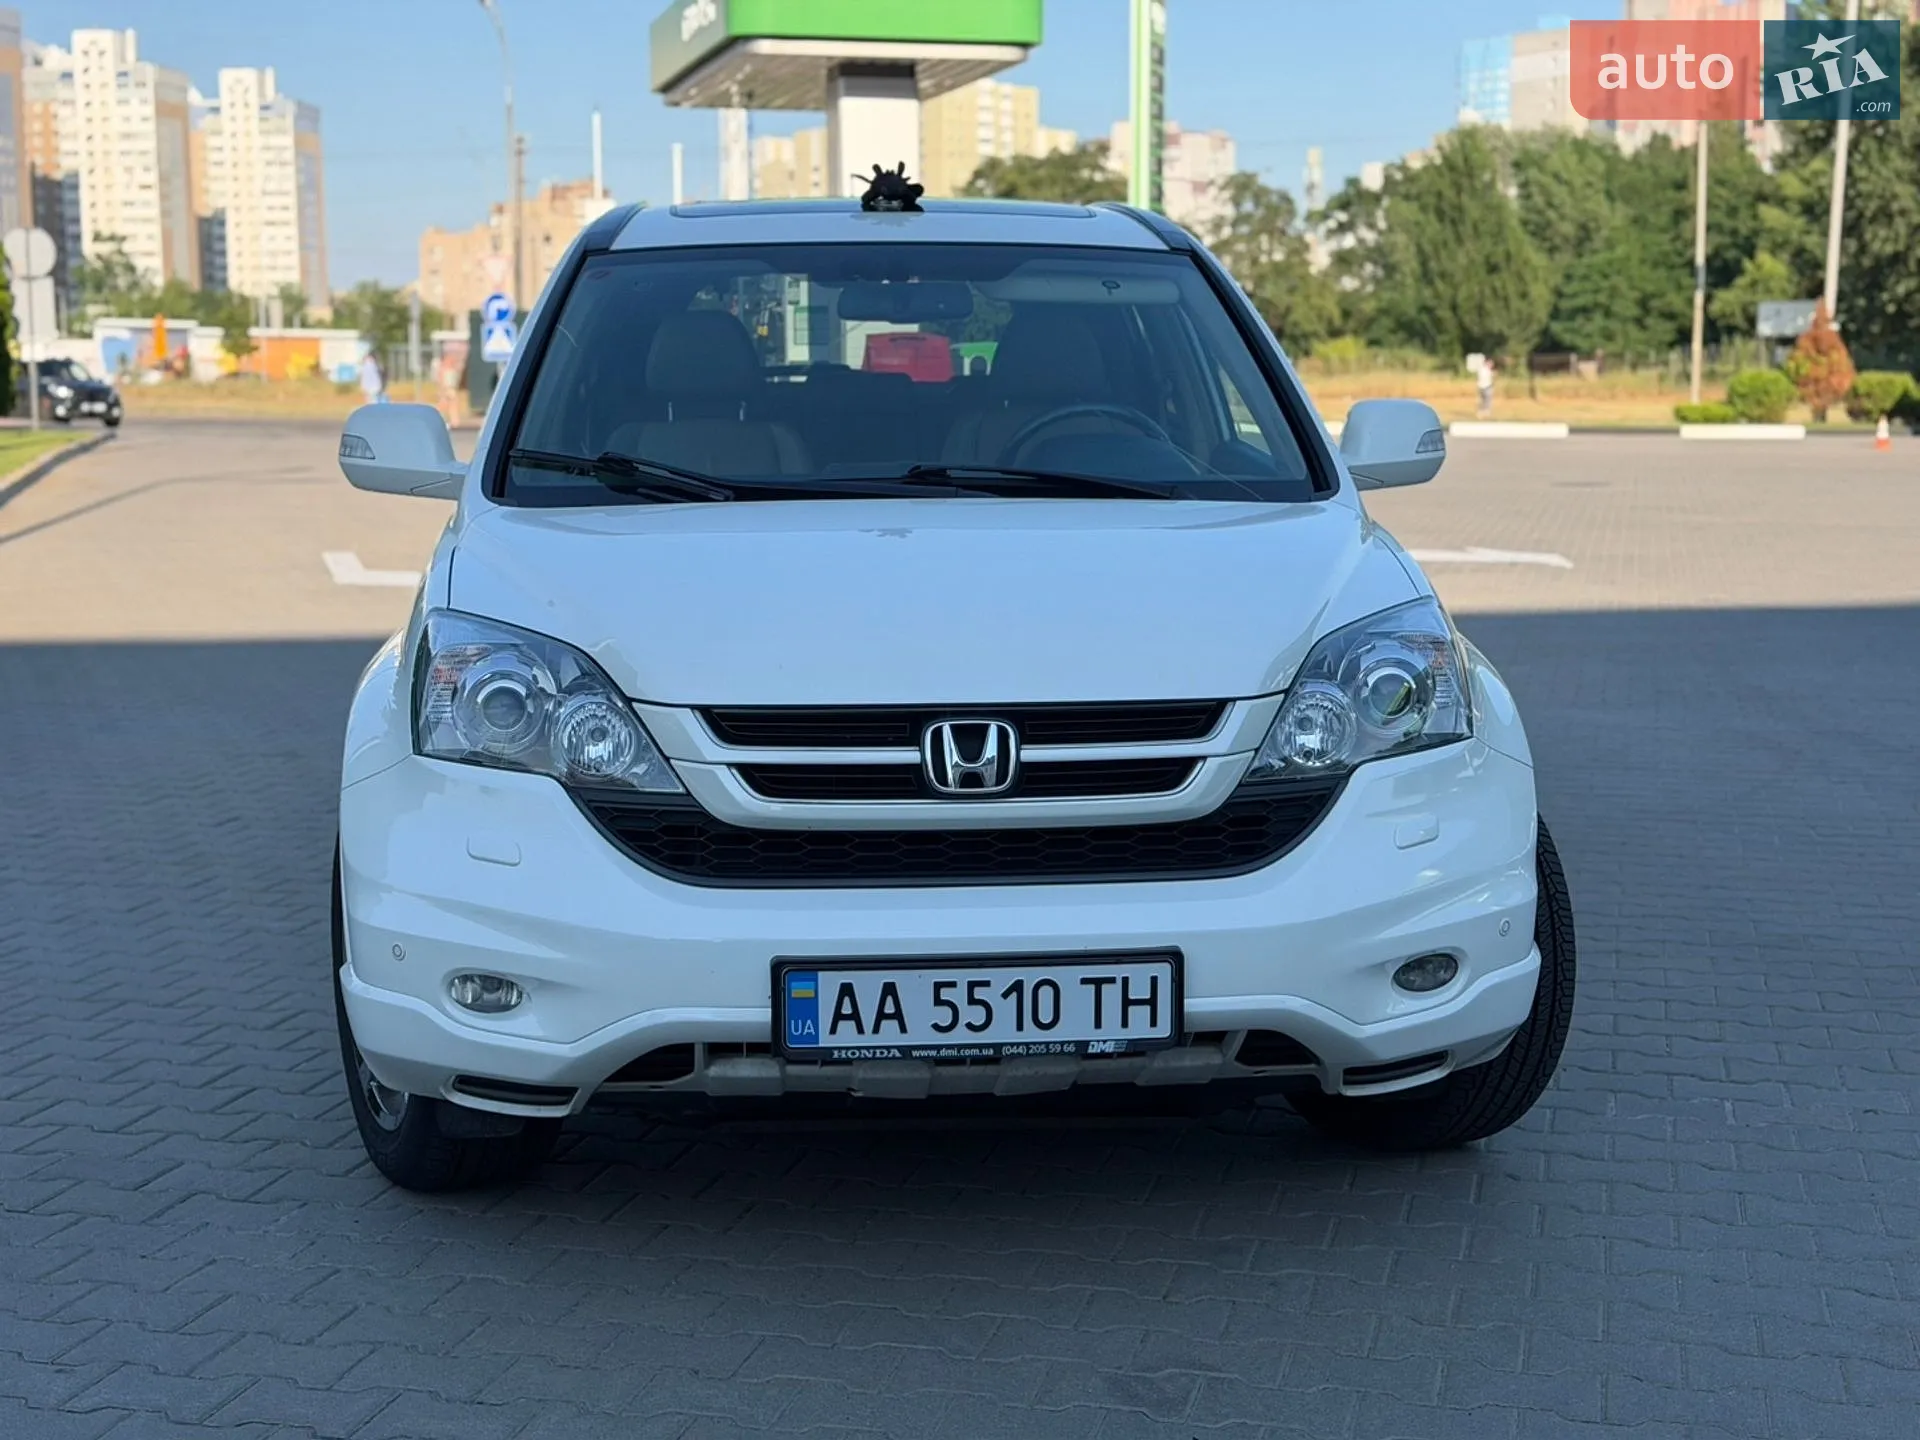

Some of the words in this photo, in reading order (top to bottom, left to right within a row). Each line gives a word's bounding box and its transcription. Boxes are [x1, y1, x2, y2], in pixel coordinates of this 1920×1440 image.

[828, 981, 909, 1036] AA
[930, 977, 1061, 1034] 5510
[1079, 975, 1159, 1030] TH
[790, 1020, 816, 1036] UA
[831, 1049, 903, 1059] HONDA
[911, 1047, 994, 1058] www.dmi.com.ua
[1001, 1045, 1027, 1056] (044)
[1028, 1044, 1047, 1055] 205
[1049, 1043, 1061, 1054] 59
[1063, 1042, 1076, 1054] 66
